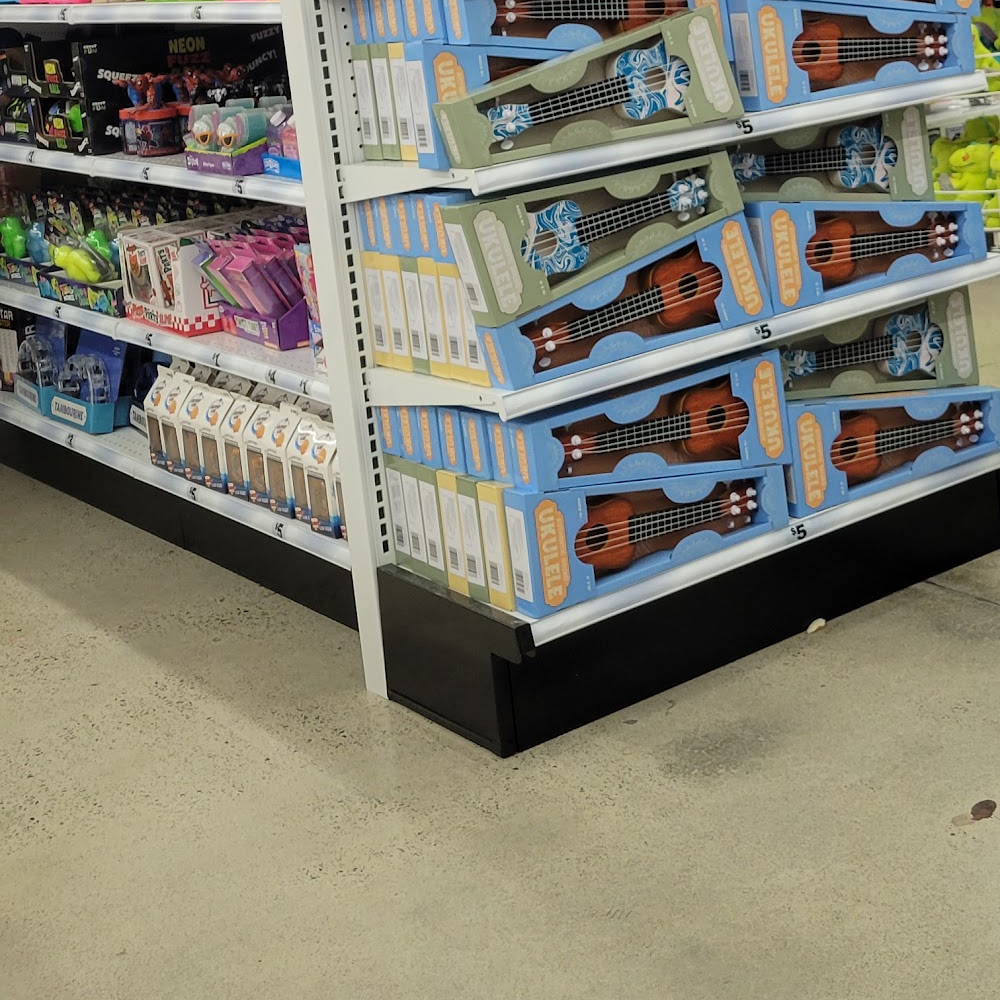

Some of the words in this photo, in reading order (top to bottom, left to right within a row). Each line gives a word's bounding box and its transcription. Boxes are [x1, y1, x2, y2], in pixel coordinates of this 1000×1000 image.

[251, 25, 281, 42] FUZZY
[168, 37, 206, 54] NEON
[247, 49, 277, 72] UNCY!
[759, 14, 784, 98] UKULELE
[97, 68, 140, 83] SQUEEZ
[736, 119, 753, 135] $5
[234, 179, 243, 196] $5
[478, 218, 519, 308] UKULELE
[773, 215, 797, 300] UKULELE
[724, 225, 762, 312] UKULELE
[754, 323, 771, 340] $5
[54, 401, 84, 421] TAMBOURINE
[756, 365, 781, 450] UKULELE
[799, 421, 822, 501] UKULELE
[275, 522, 284, 538] $5
[791, 523, 808, 540] $5
[536, 507, 563, 602] UKULELE
